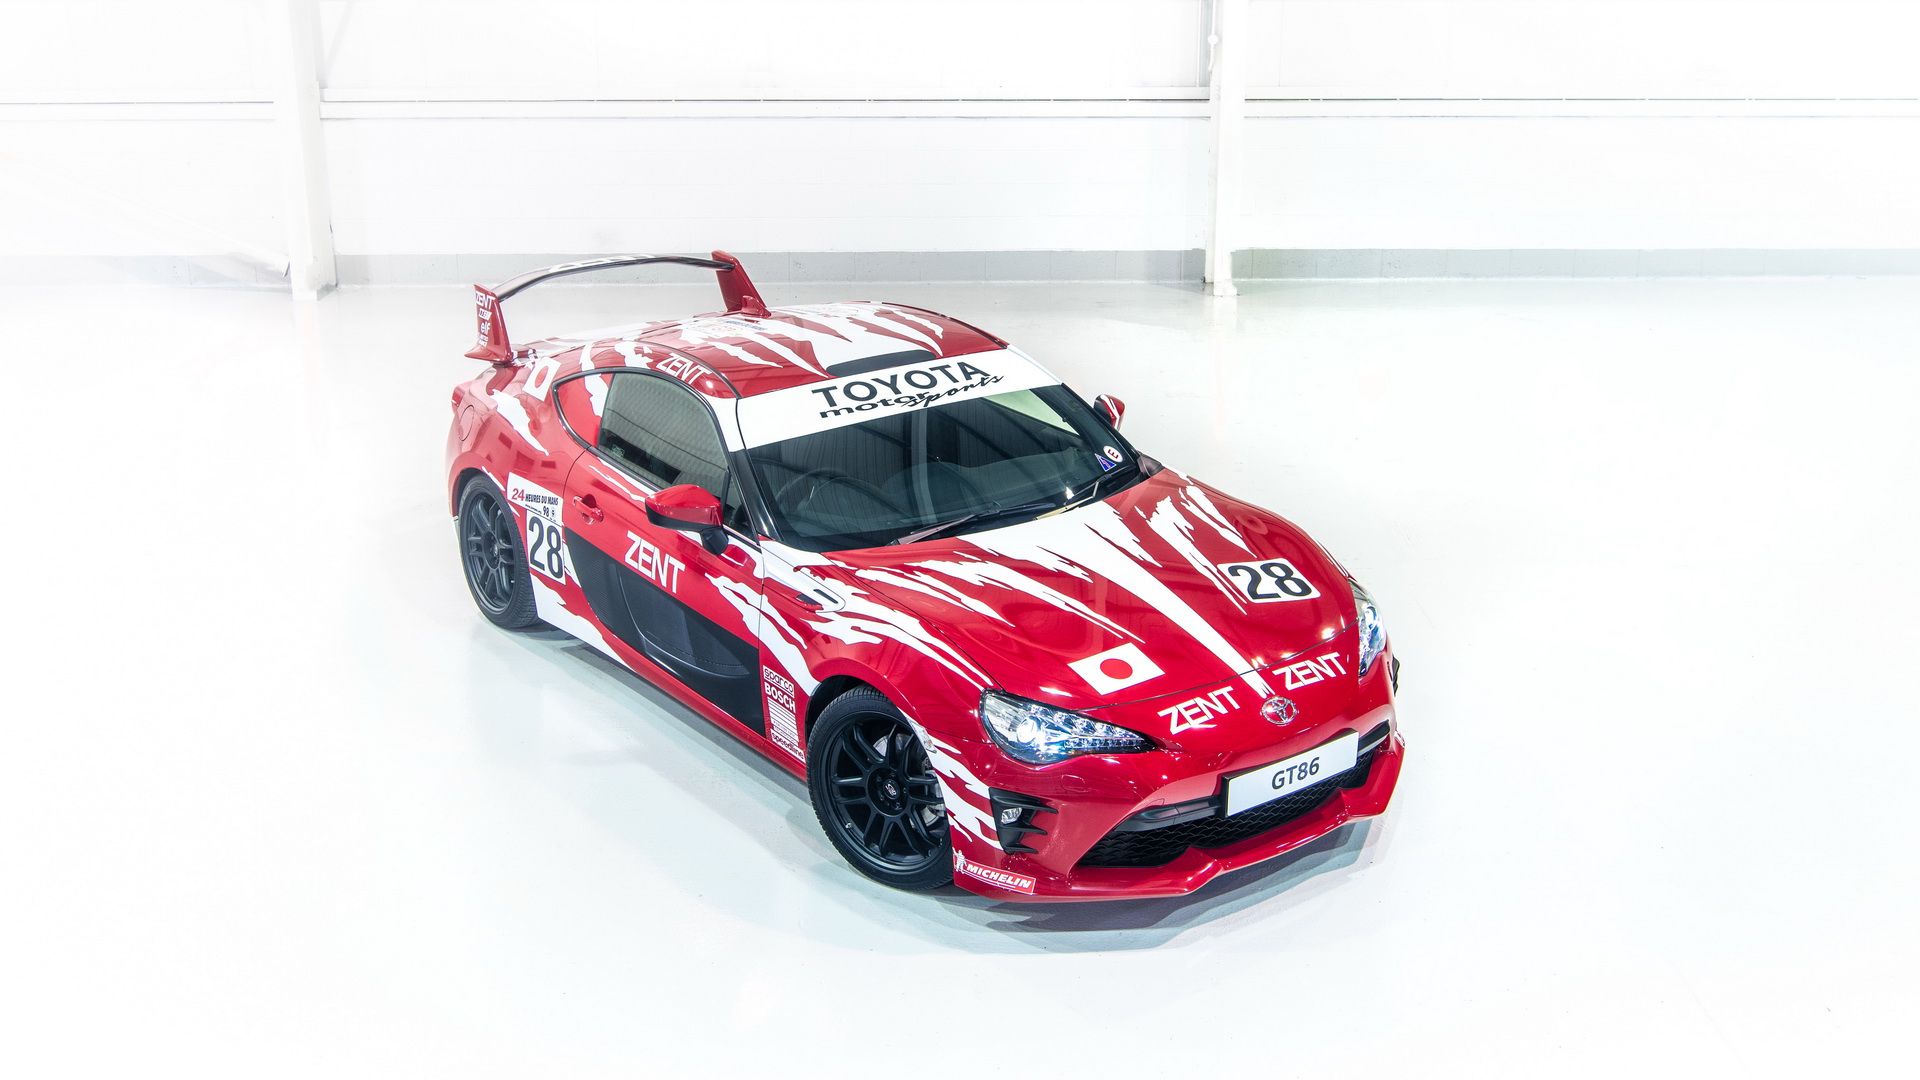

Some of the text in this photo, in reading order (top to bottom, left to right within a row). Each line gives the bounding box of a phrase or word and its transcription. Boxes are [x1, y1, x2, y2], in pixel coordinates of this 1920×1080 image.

[656, 352, 712, 385] ZENT
[811, 361, 991, 408] TOYOTA
[511, 488, 559, 506] 24 HEURES DU MANS
[542, 506, 549, 517] 98
[528, 516, 563, 579] 28
[625, 530, 686, 594] ZENT
[1227, 562, 1312, 600] 28
[764, 668, 794, 693] sparco
[1272, 651, 1347, 691] ZENT
[764, 681, 796, 713] BOSCH
[1157, 685, 1240, 735] ZENT
[1271, 756, 1320, 790] GT86
[966, 864, 1032, 889] MICHELIN
